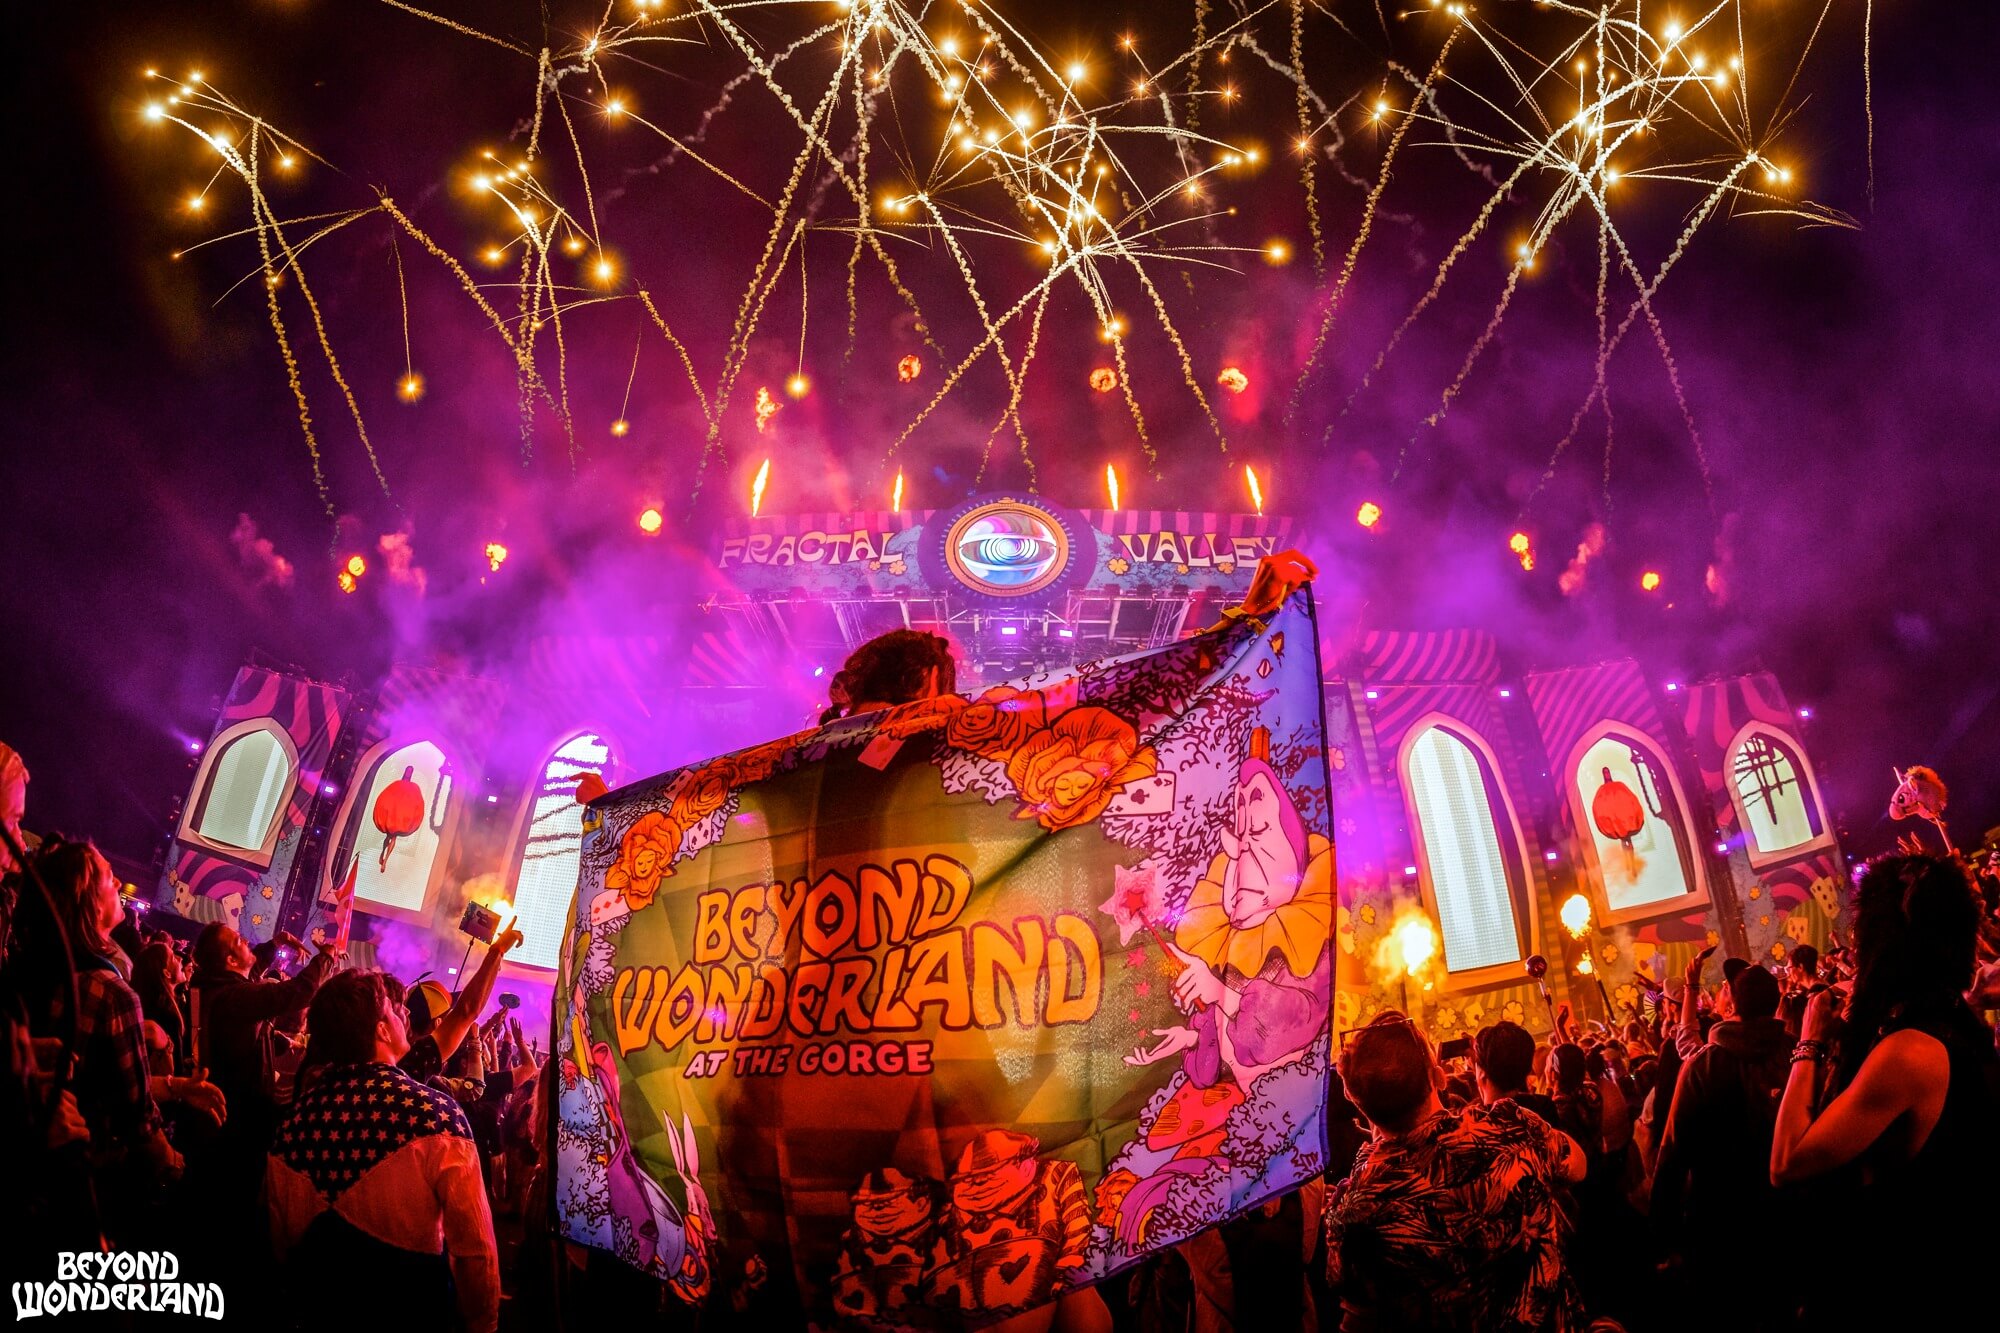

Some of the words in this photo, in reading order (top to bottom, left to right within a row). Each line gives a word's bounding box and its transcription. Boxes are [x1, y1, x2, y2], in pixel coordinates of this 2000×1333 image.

[718, 529, 903, 568] FRACTAL
[1117, 531, 1276, 568] VALLEY
[693, 855, 973, 965] BEYOND
[612, 912, 1102, 1057] WONDERLAND
[683, 1051, 729, 1078] AT
[734, 1047, 791, 1076] THE
[798, 1042, 933, 1076] GORGE
